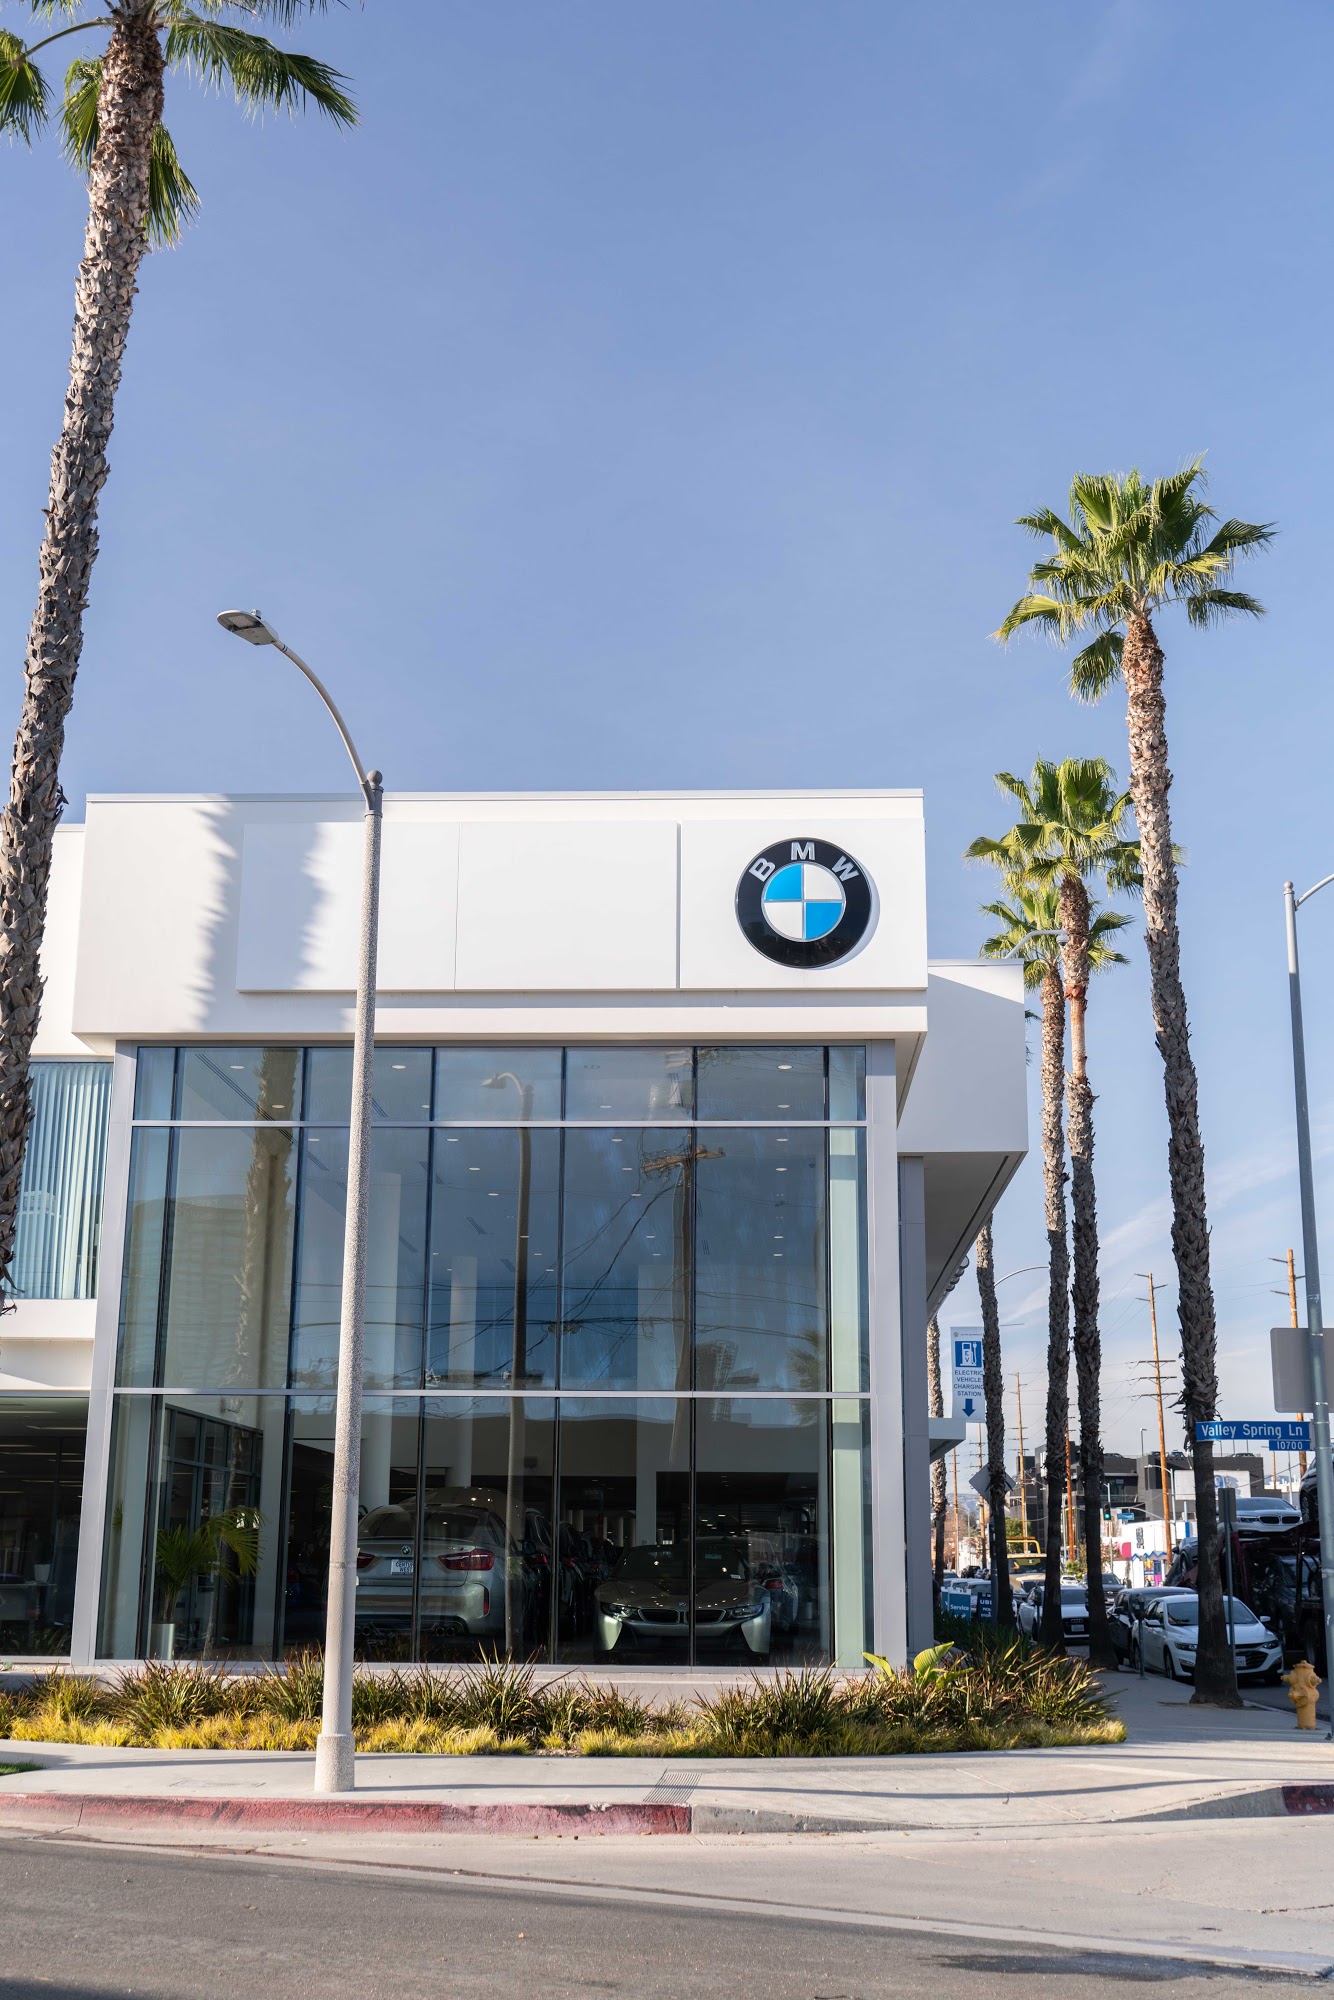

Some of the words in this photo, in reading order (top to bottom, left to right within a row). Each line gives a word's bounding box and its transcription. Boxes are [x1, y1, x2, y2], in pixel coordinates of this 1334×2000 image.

[749, 841, 859, 882] BMW
[1201, 1424, 1236, 1438] Valley
[1242, 1423, 1282, 1439] Spring
[1288, 1424, 1303, 1436] Ln
[1276, 1441, 1303, 1450] 10700
